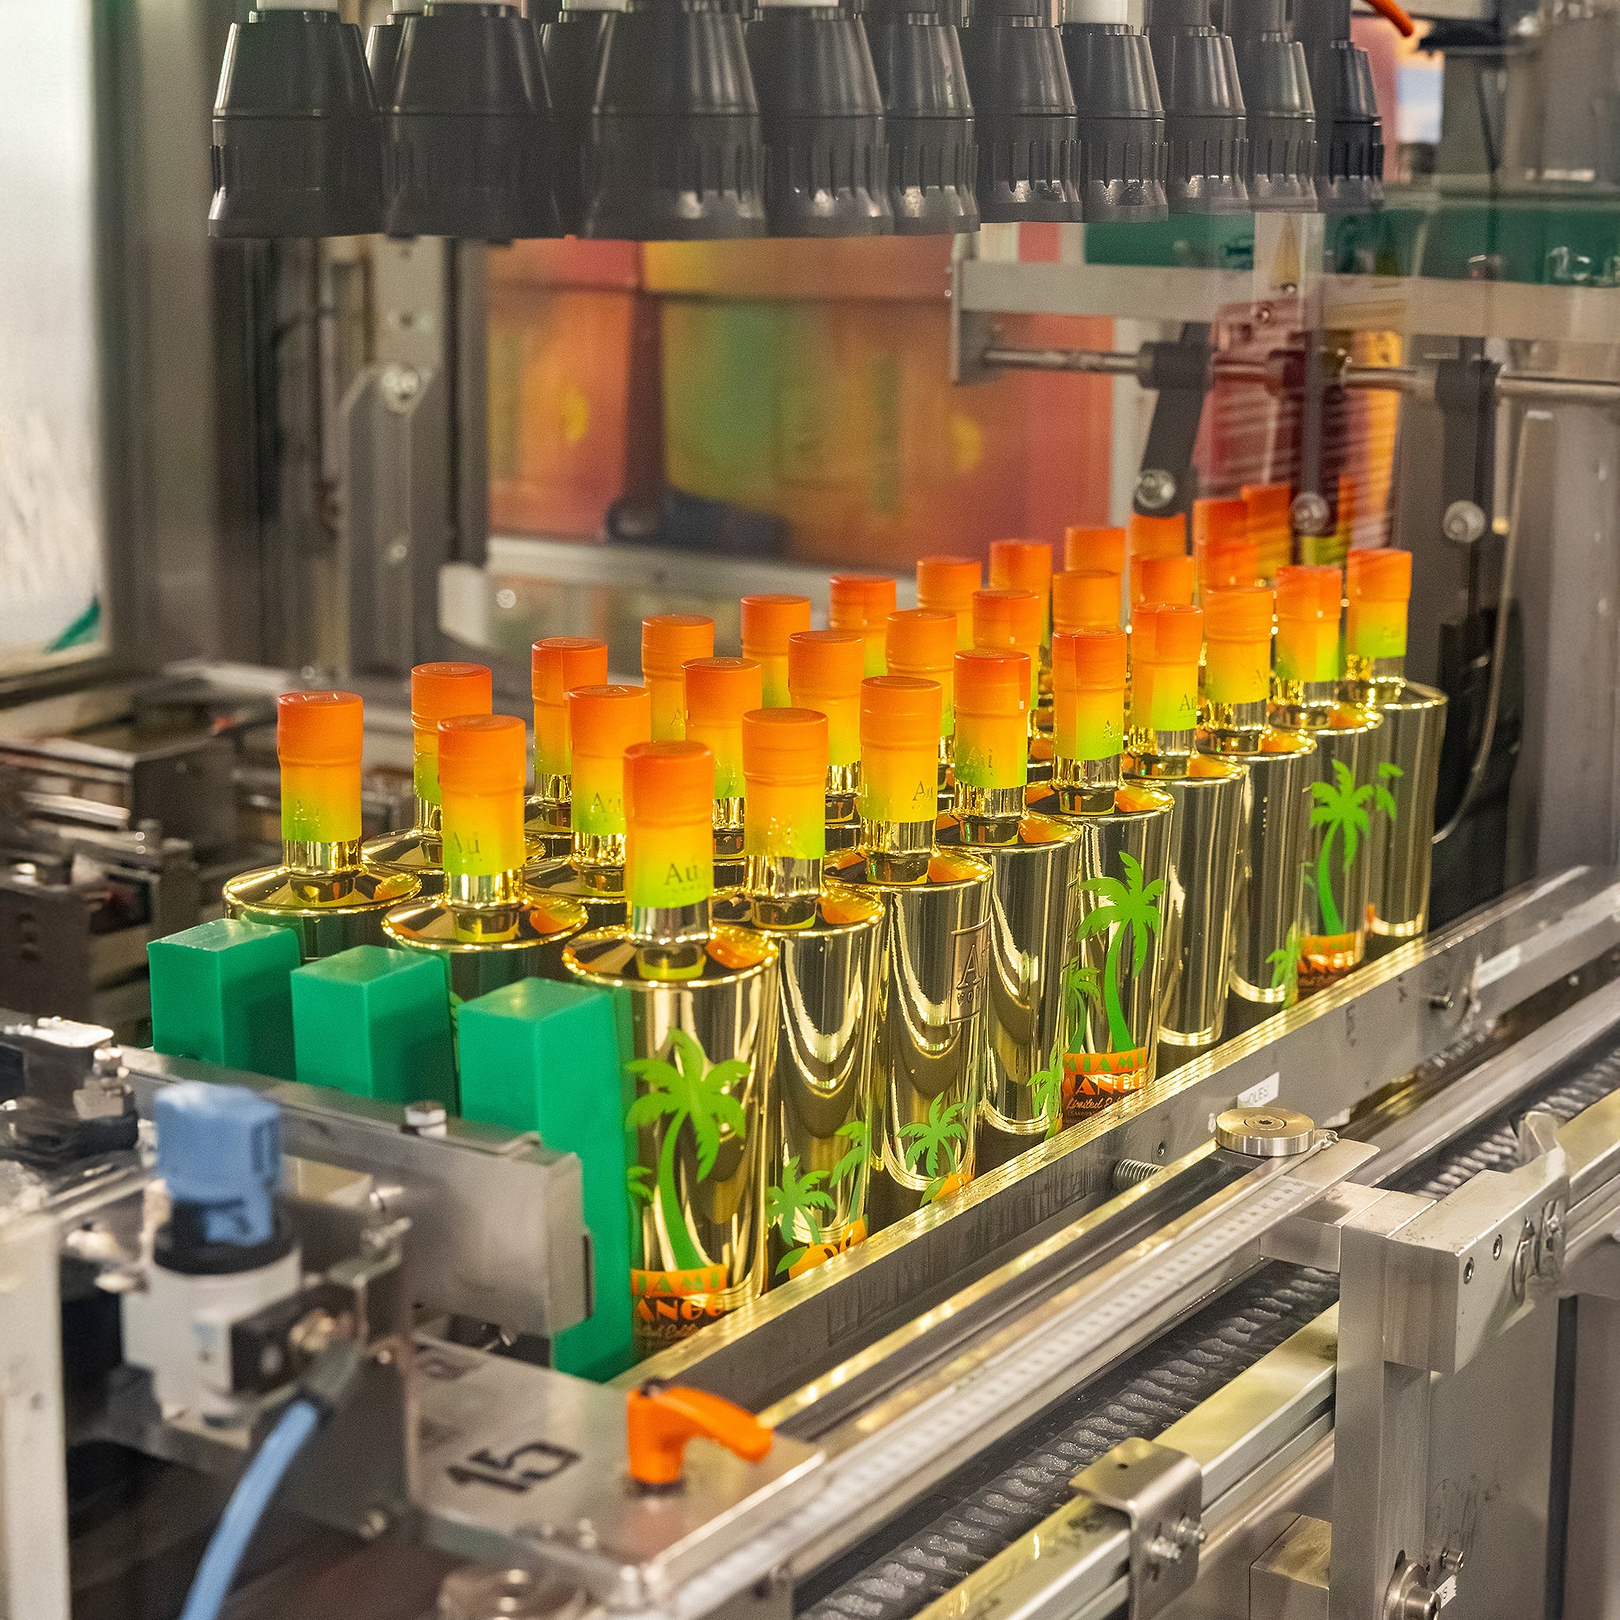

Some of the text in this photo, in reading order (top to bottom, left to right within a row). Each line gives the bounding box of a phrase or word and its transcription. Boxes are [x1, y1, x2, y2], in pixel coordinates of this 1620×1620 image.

[663, 862, 699, 886] Au
[1062, 1051, 1143, 1072] MIAMI
[447, 1441, 582, 1494] 15
